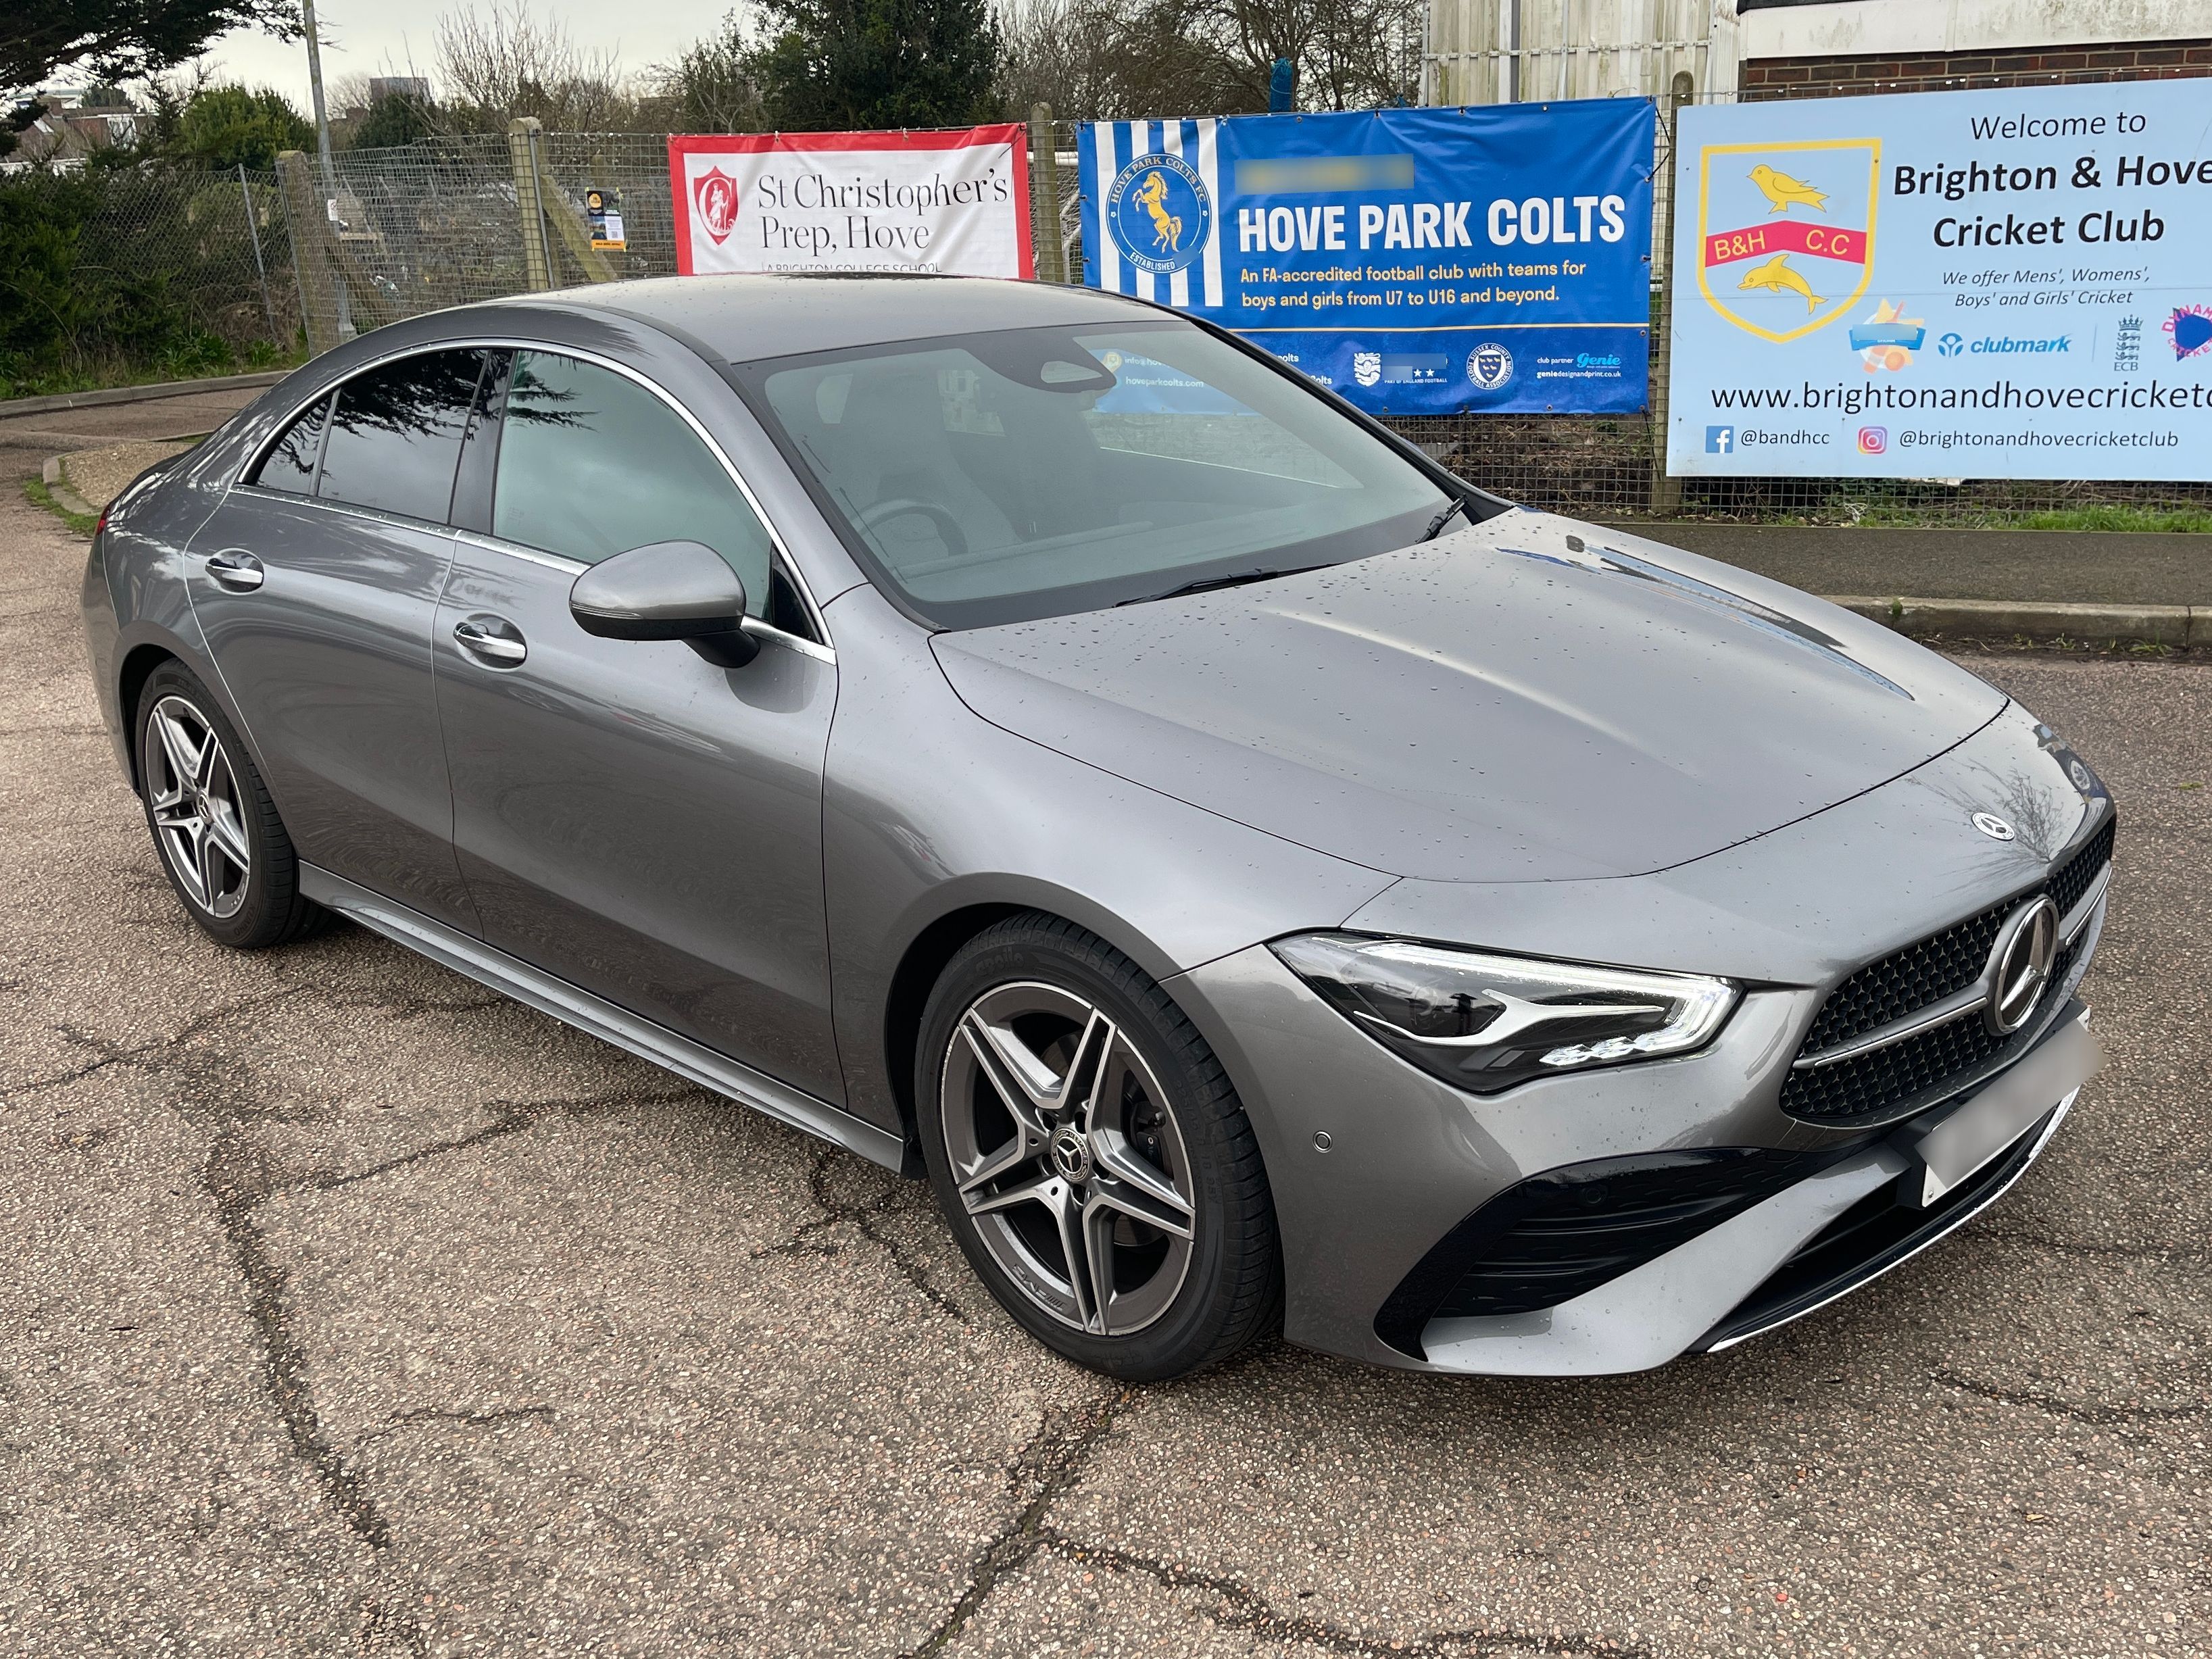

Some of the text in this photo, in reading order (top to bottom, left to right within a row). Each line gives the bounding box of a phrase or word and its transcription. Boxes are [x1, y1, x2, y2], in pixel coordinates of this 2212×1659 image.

[1971, 112, 2146, 140] Welcome to
[1110, 156, 1207, 204] HOVE PARK COLTS FC
[1894, 155, 2212, 201] Brighton & Hove
[758, 168, 1008, 216] St Christopher's
[1238, 205, 1346, 253] HOVE
[1359, 201, 1473, 250] PARK
[1488, 194, 1625, 246] COLTS
[1934, 209, 2164, 247] Cricket Club
[761, 215, 931, 257] Prep, Hove
[1714, 230, 1766, 261] B&H
[1129, 251, 1176, 271] ESTABLISHED
[1241, 259, 1586, 282] An FA-accredited football club with teams for
[1943, 266, 2150, 287] We offer Mens', Womens',
[1242, 285, 1560, 312] boys and girls from U7 to U16 and beyond.
[1955, 290, 2134, 309] Boys' and Girls' Cricket
[1970, 334, 2073, 355] clubmark
[1576, 353, 1621, 368] Genie
[2114, 362, 2138, 372] ECB
[1125, 376, 1204, 388] hoveparkcolts.com
[1741, 430, 1830, 447] @bandhcc
[1900, 430, 2178, 451] @brightonandhovecricketclub
